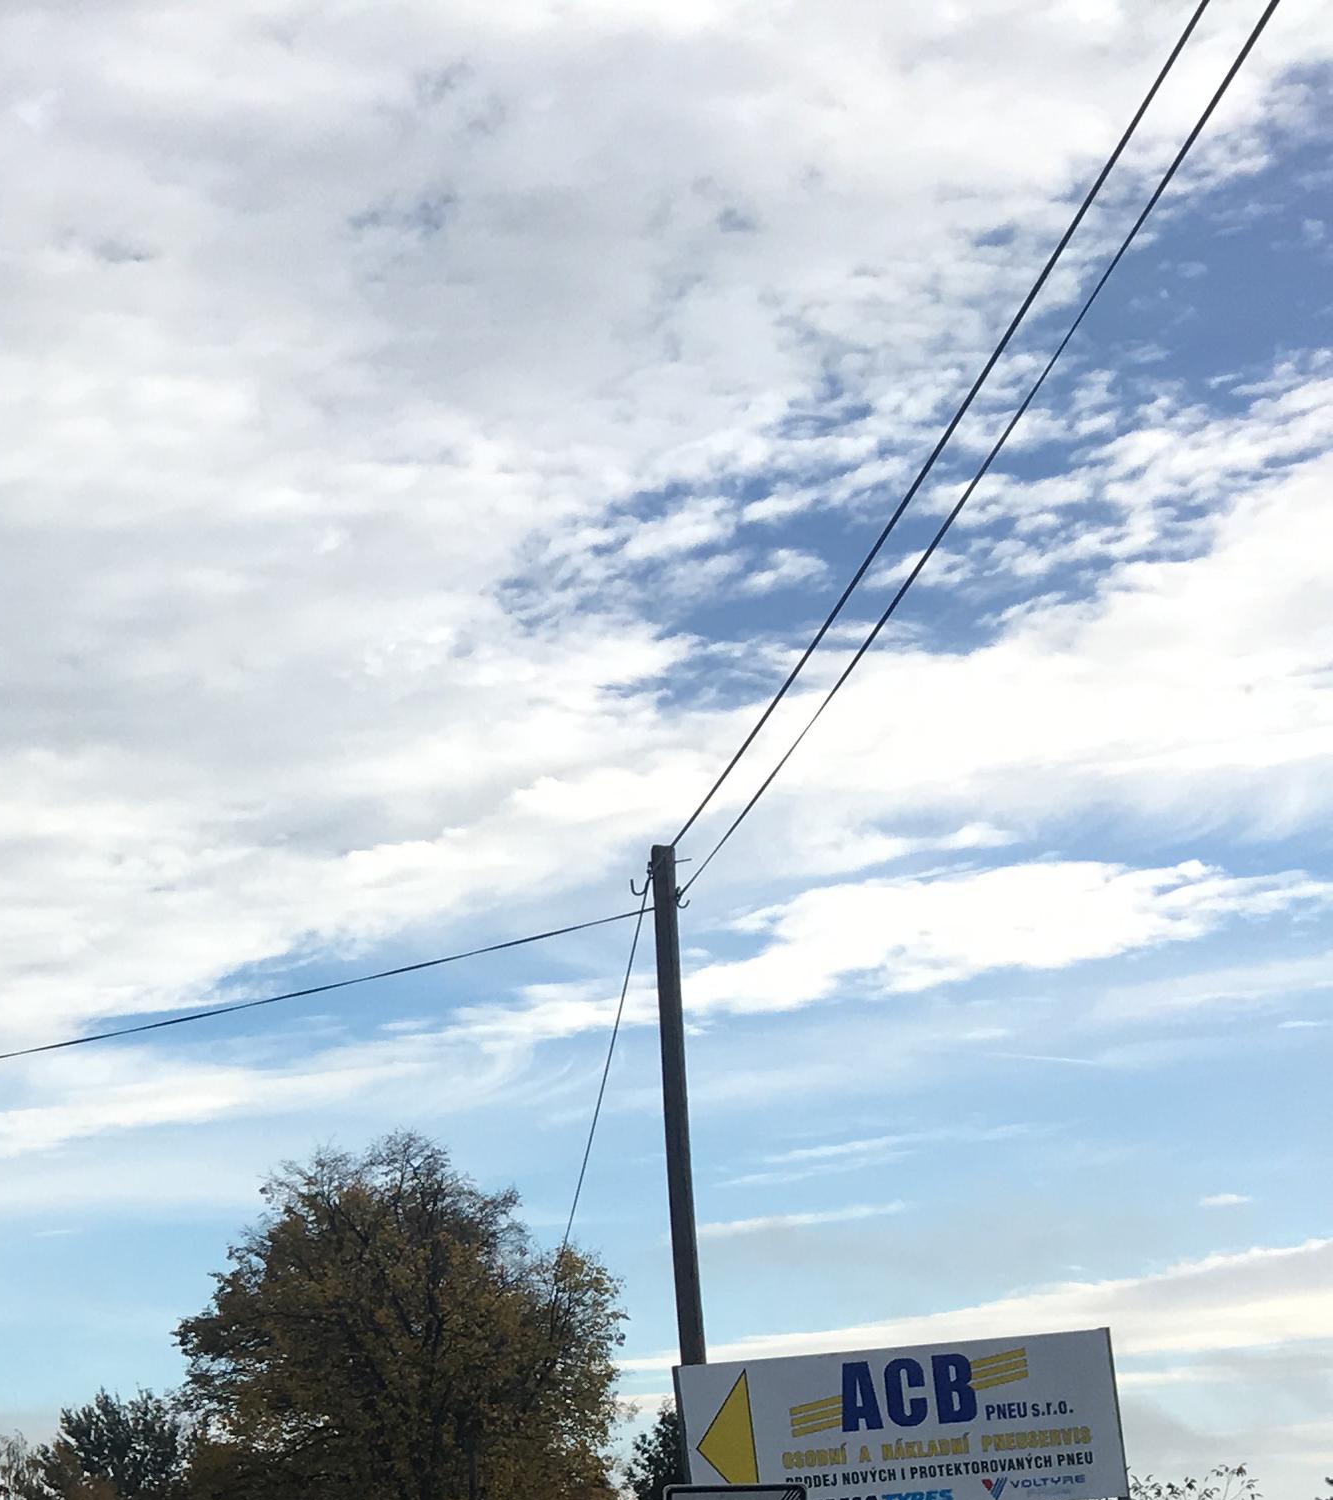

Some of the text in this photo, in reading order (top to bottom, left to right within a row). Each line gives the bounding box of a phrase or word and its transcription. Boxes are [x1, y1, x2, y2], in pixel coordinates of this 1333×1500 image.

[842, 1353, 1075, 1432] ACB PNEU s.r.o.
[782, 1426, 1093, 1469] OSOBNÍ A NÁKLADNÍ PNEUSERVIS
[841, 1466, 897, 1485] NOVÝCH
[910, 1454, 1053, 1480] PROTEKTOROVANÝCH
[1057, 1451, 1094, 1467] PNEU
[1010, 1474, 1086, 1488] VOLTYRE
